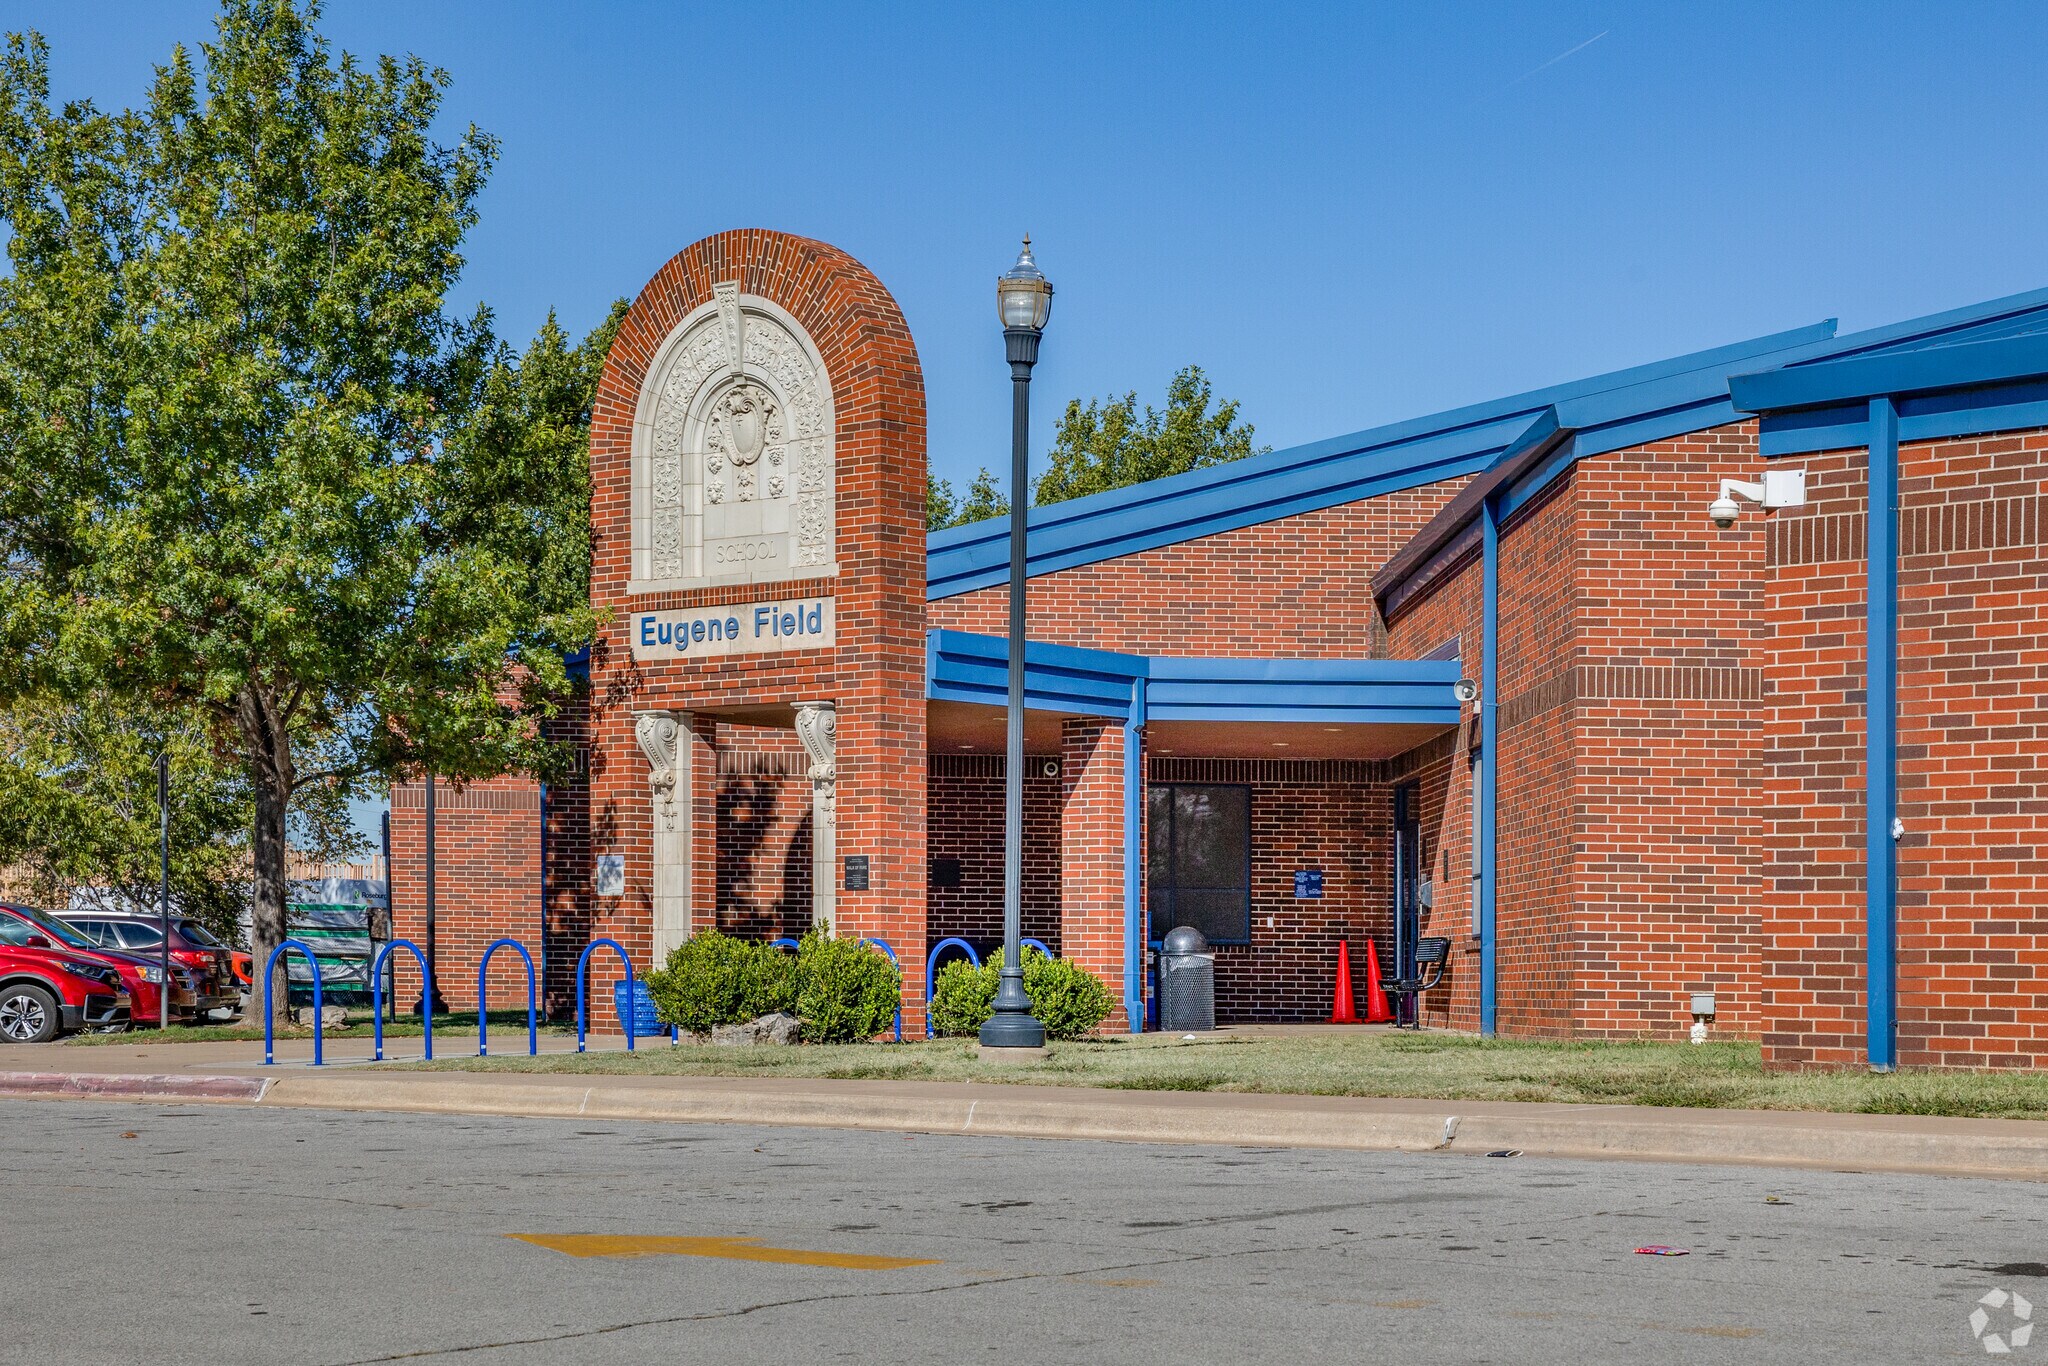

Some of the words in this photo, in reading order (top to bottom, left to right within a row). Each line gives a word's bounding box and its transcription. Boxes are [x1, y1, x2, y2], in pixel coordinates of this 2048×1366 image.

[716, 542, 777, 563] SCHOOL
[641, 616, 739, 651] Eugene
[754, 603, 822, 638] Field
